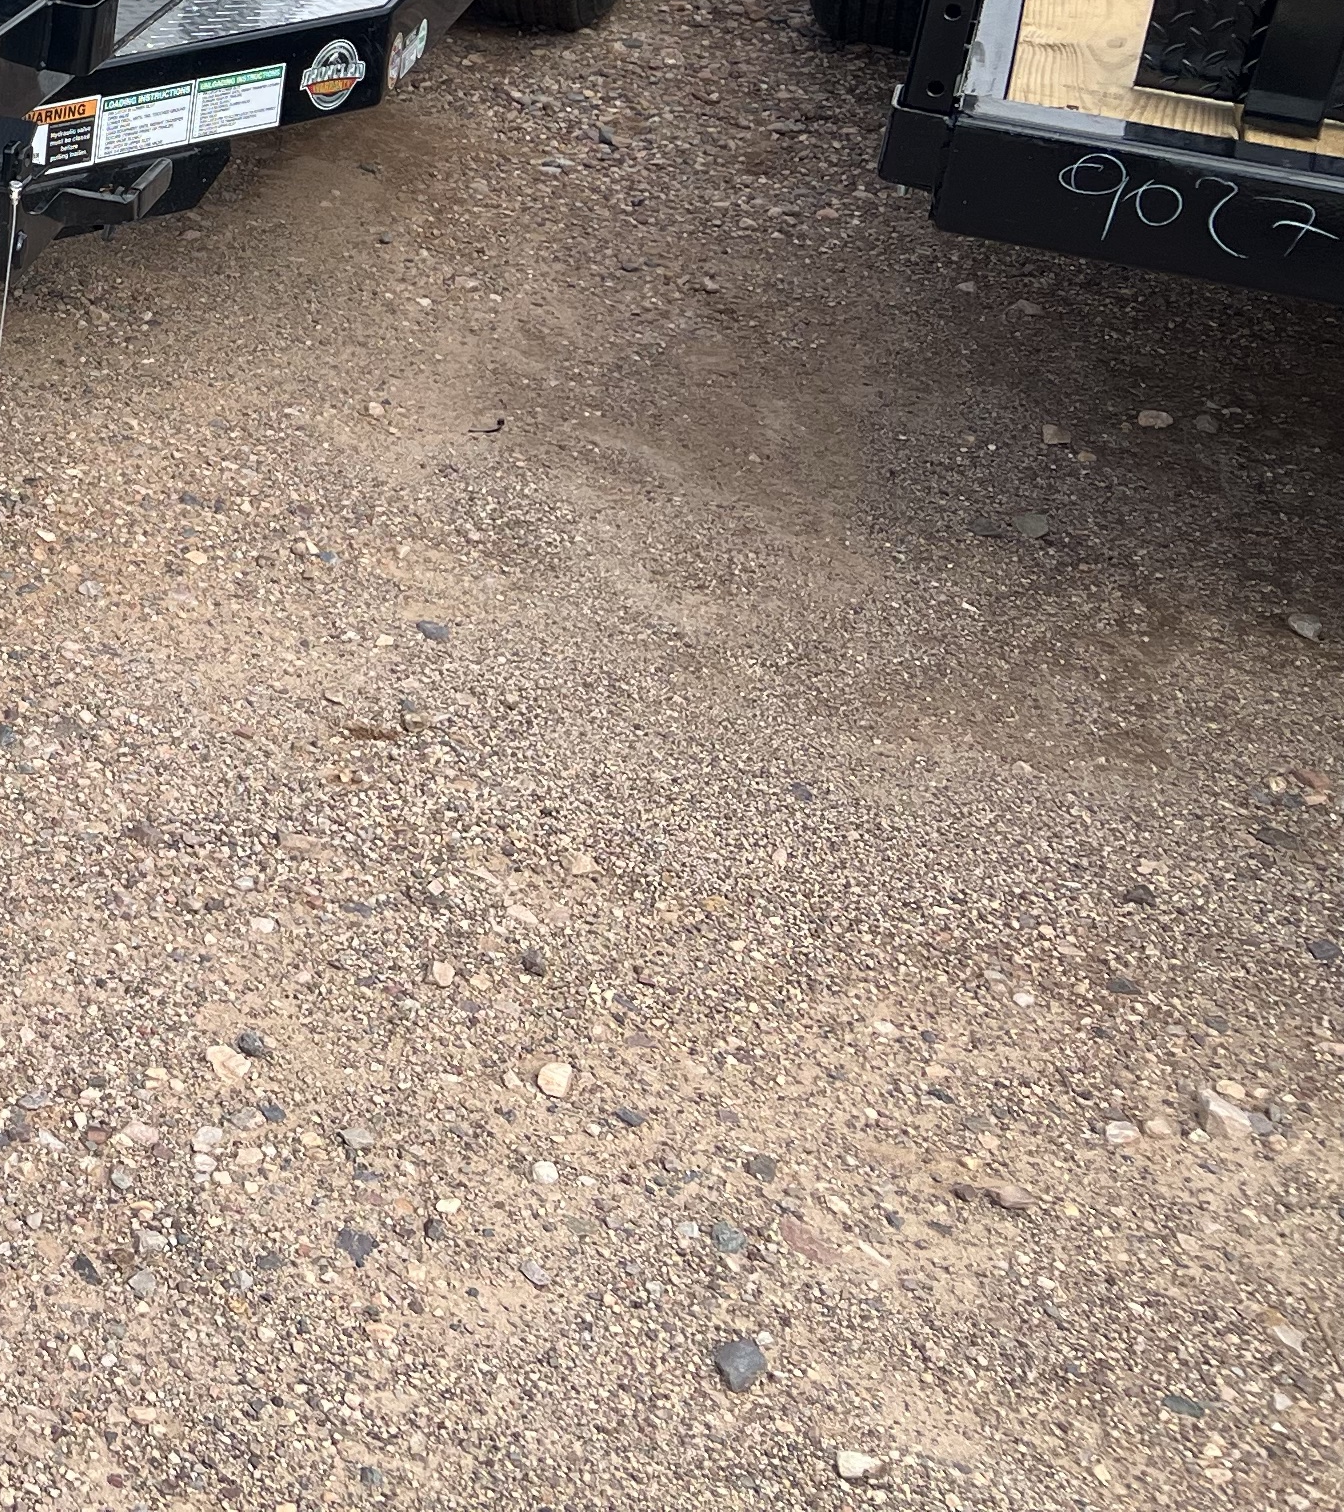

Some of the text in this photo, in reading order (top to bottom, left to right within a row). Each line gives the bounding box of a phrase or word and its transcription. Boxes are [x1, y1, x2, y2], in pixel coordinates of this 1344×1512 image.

[105, 85, 191, 110] LOADING INSTRUCTIONS
[60, 143, 79, 152] before
